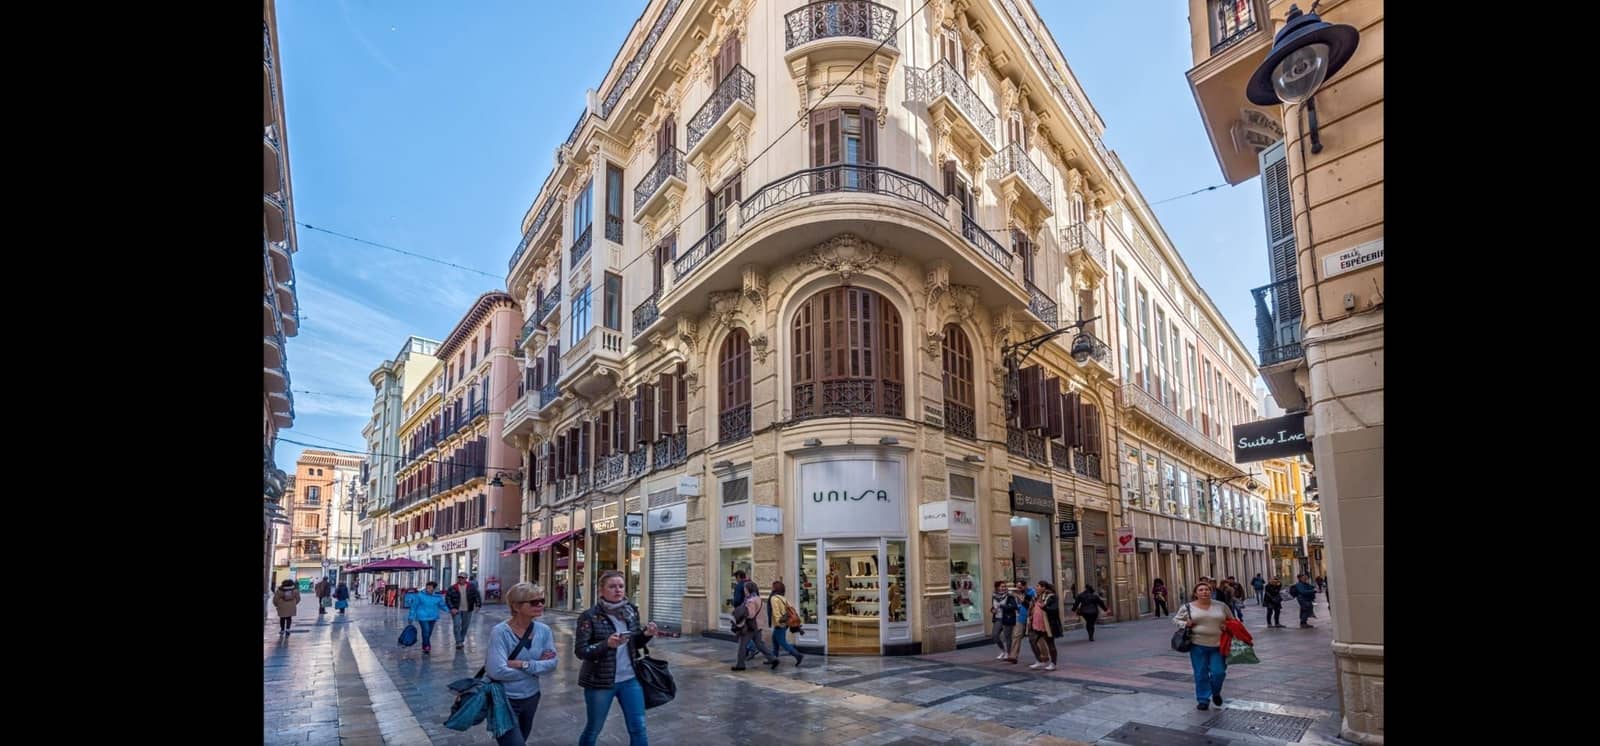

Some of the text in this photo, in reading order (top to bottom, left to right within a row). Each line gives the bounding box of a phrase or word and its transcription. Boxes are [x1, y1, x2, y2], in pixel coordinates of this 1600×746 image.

[1340, 250, 1358, 260] CALLE
[1238, 436, 1275, 448] Suits
[813, 490, 888, 504] UNISA
